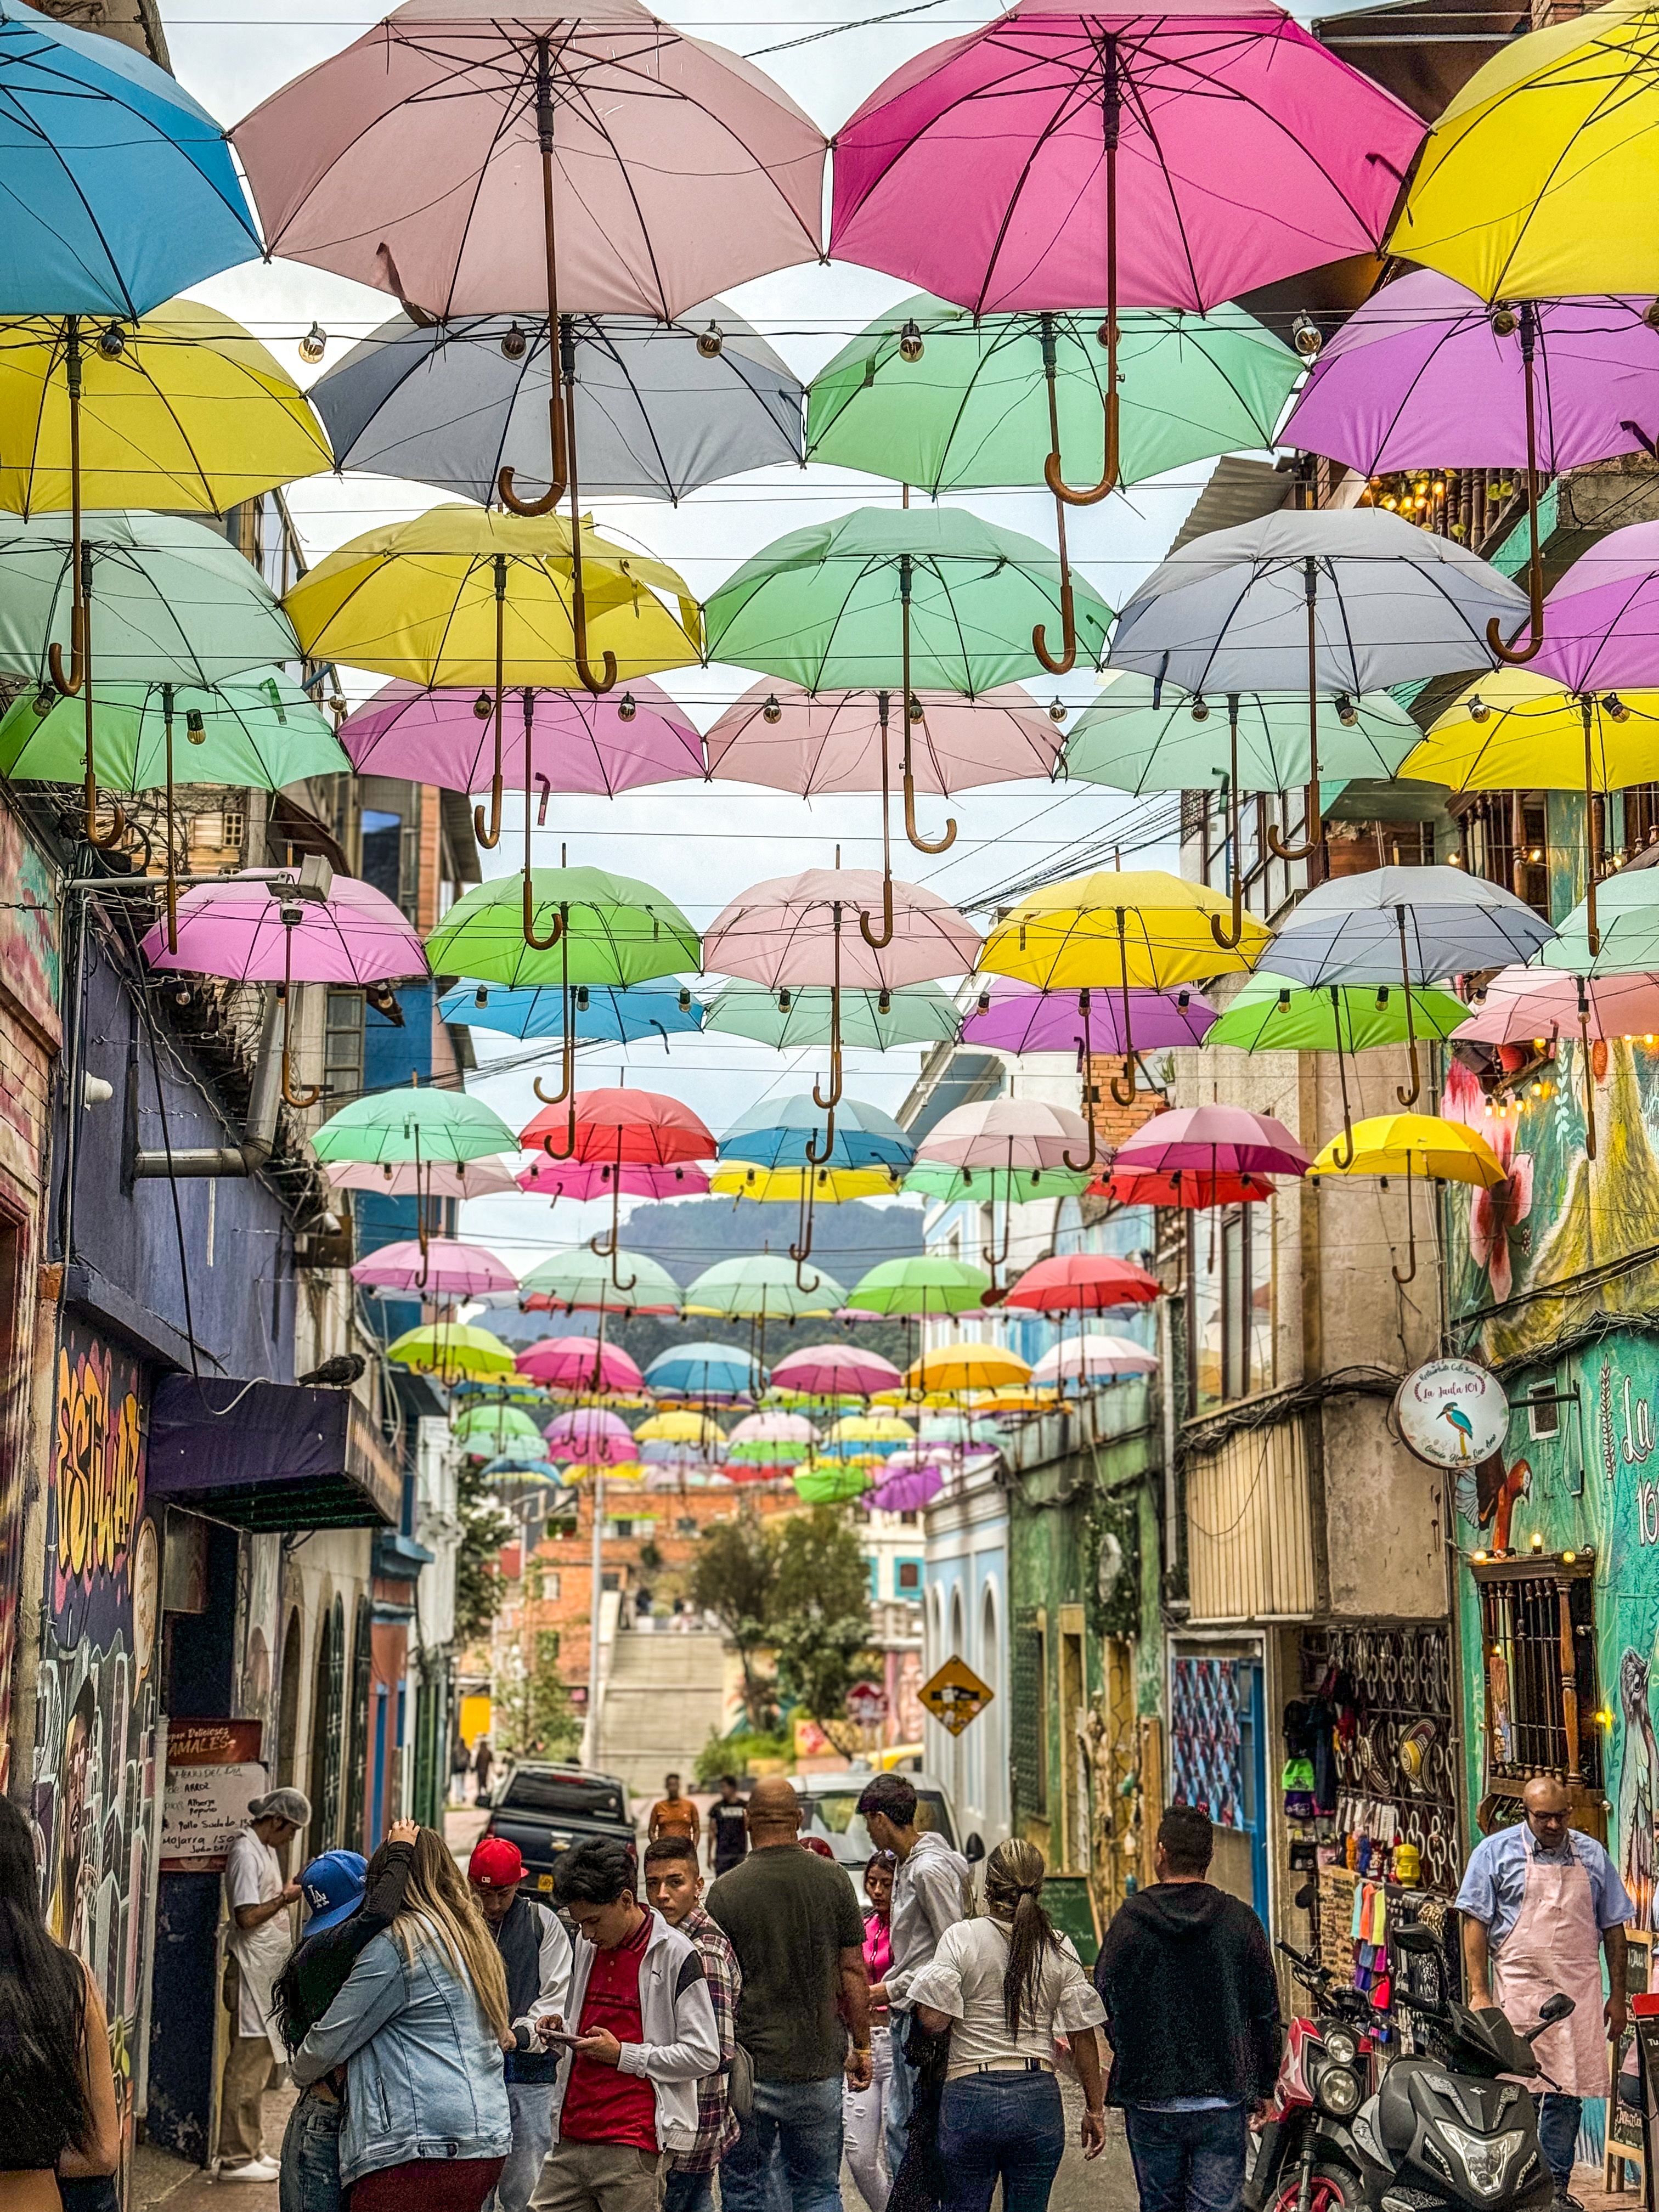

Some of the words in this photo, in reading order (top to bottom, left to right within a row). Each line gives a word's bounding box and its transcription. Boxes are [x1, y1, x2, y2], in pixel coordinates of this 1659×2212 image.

[1424, 1389, 1435, 1398] La
[1438, 1382, 1464, 1398] Jaula
[1465, 1382, 1477, 1393] 101
[1622, 1375, 1656, 1464] La
[1635, 1476, 1659, 1547] 10
[168, 1733, 185, 1742] per
[168, 1735, 229, 1756] AMALES
[308, 1884, 330, 1909] LA
